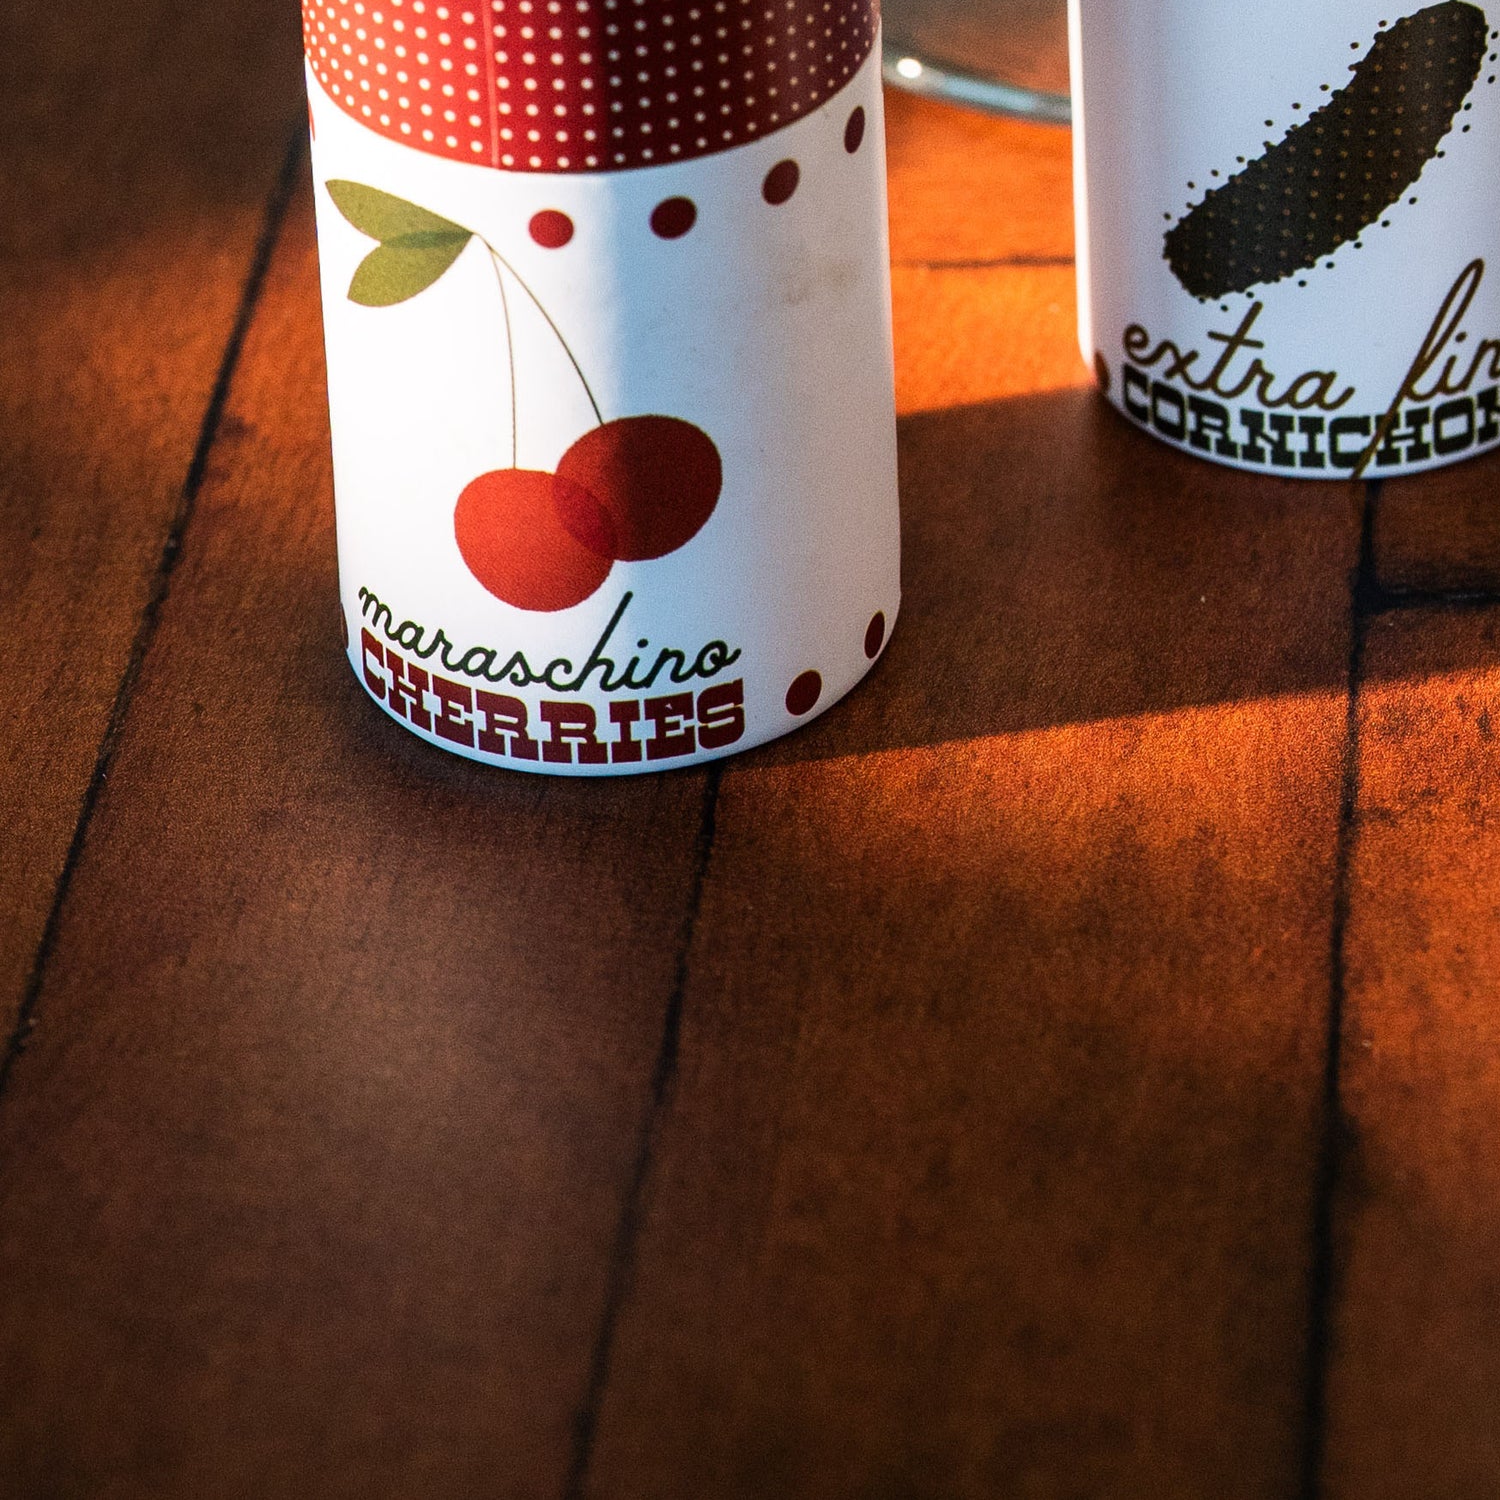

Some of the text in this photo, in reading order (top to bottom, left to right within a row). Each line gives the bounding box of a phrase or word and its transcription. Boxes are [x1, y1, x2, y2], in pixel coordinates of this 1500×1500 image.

[1123, 301, 1356, 411] extra
[358, 585, 742, 693] maraschino
[360, 626, 745, 765] CHERRIES
